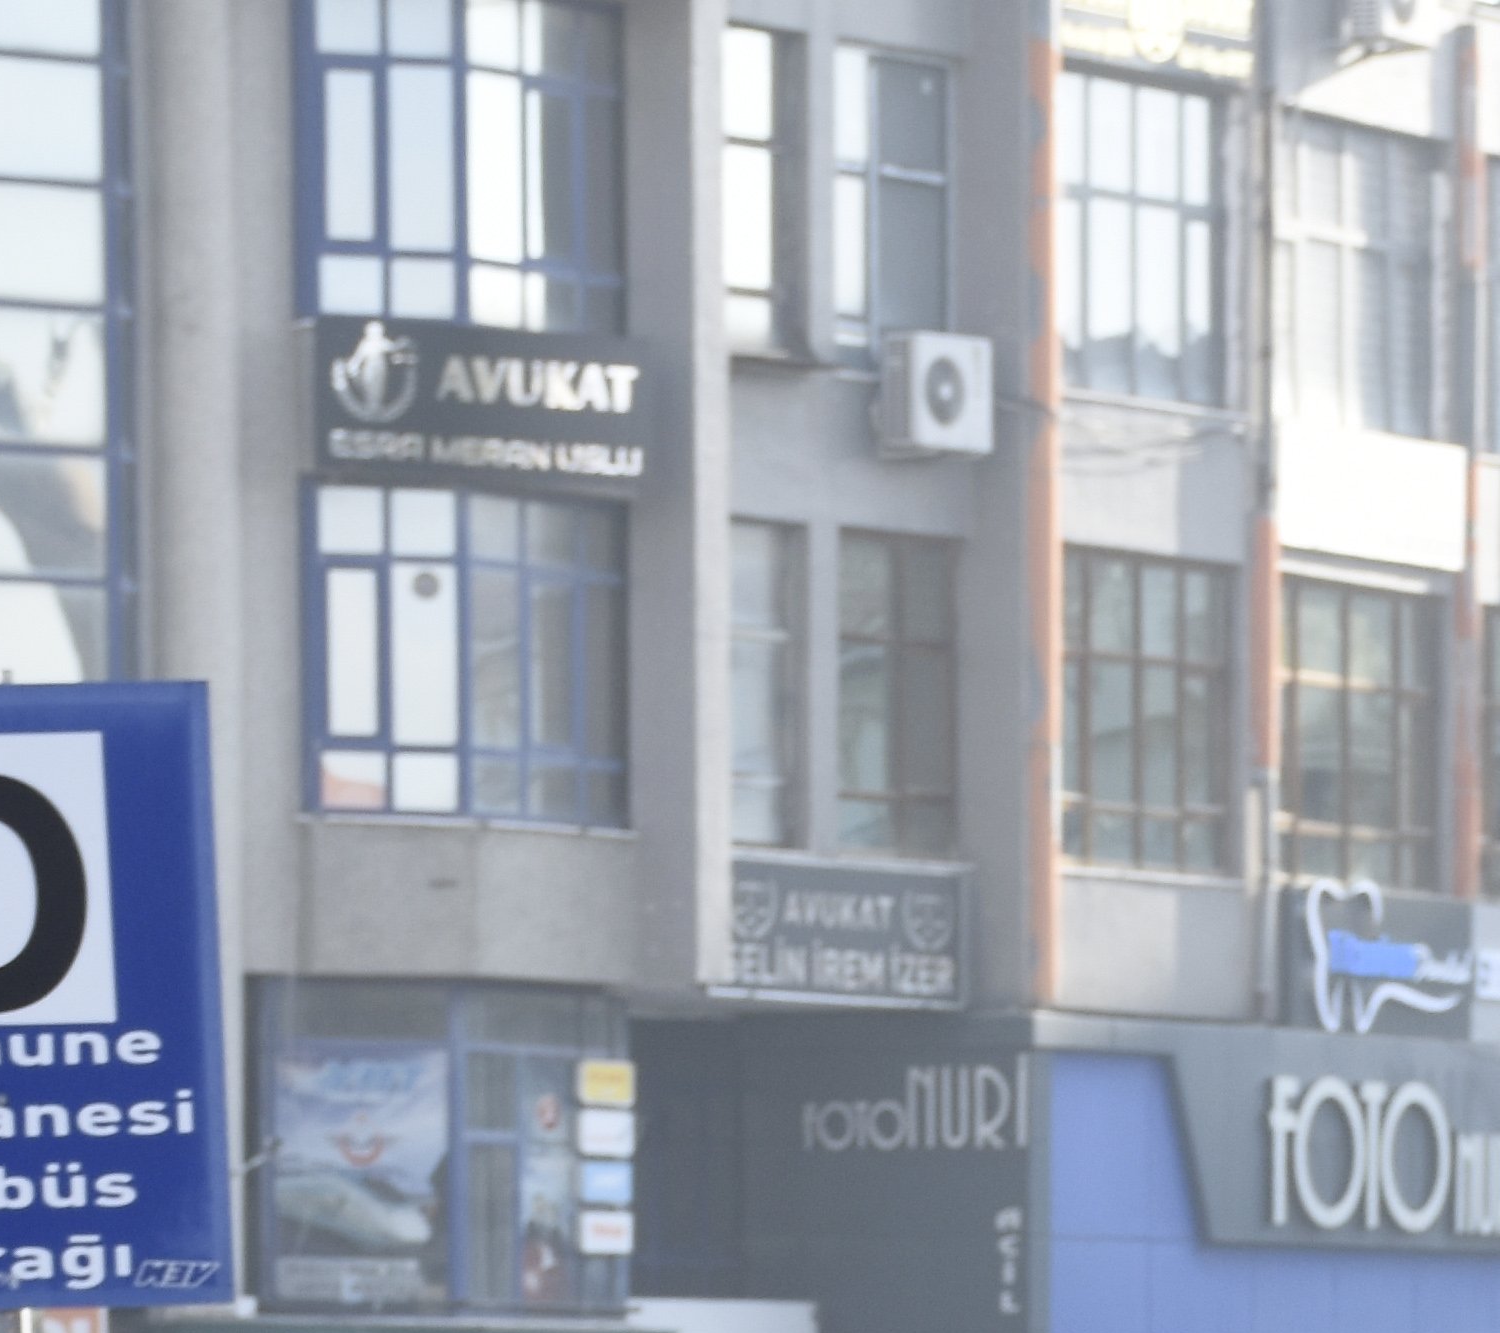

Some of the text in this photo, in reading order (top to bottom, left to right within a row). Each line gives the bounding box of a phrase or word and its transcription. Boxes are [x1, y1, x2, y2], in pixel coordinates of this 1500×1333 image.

[437, 356, 640, 414] AVUKAT
[783, 889, 895, 932] AVUKAT
[1269, 1075, 1451, 1234] FOTO
